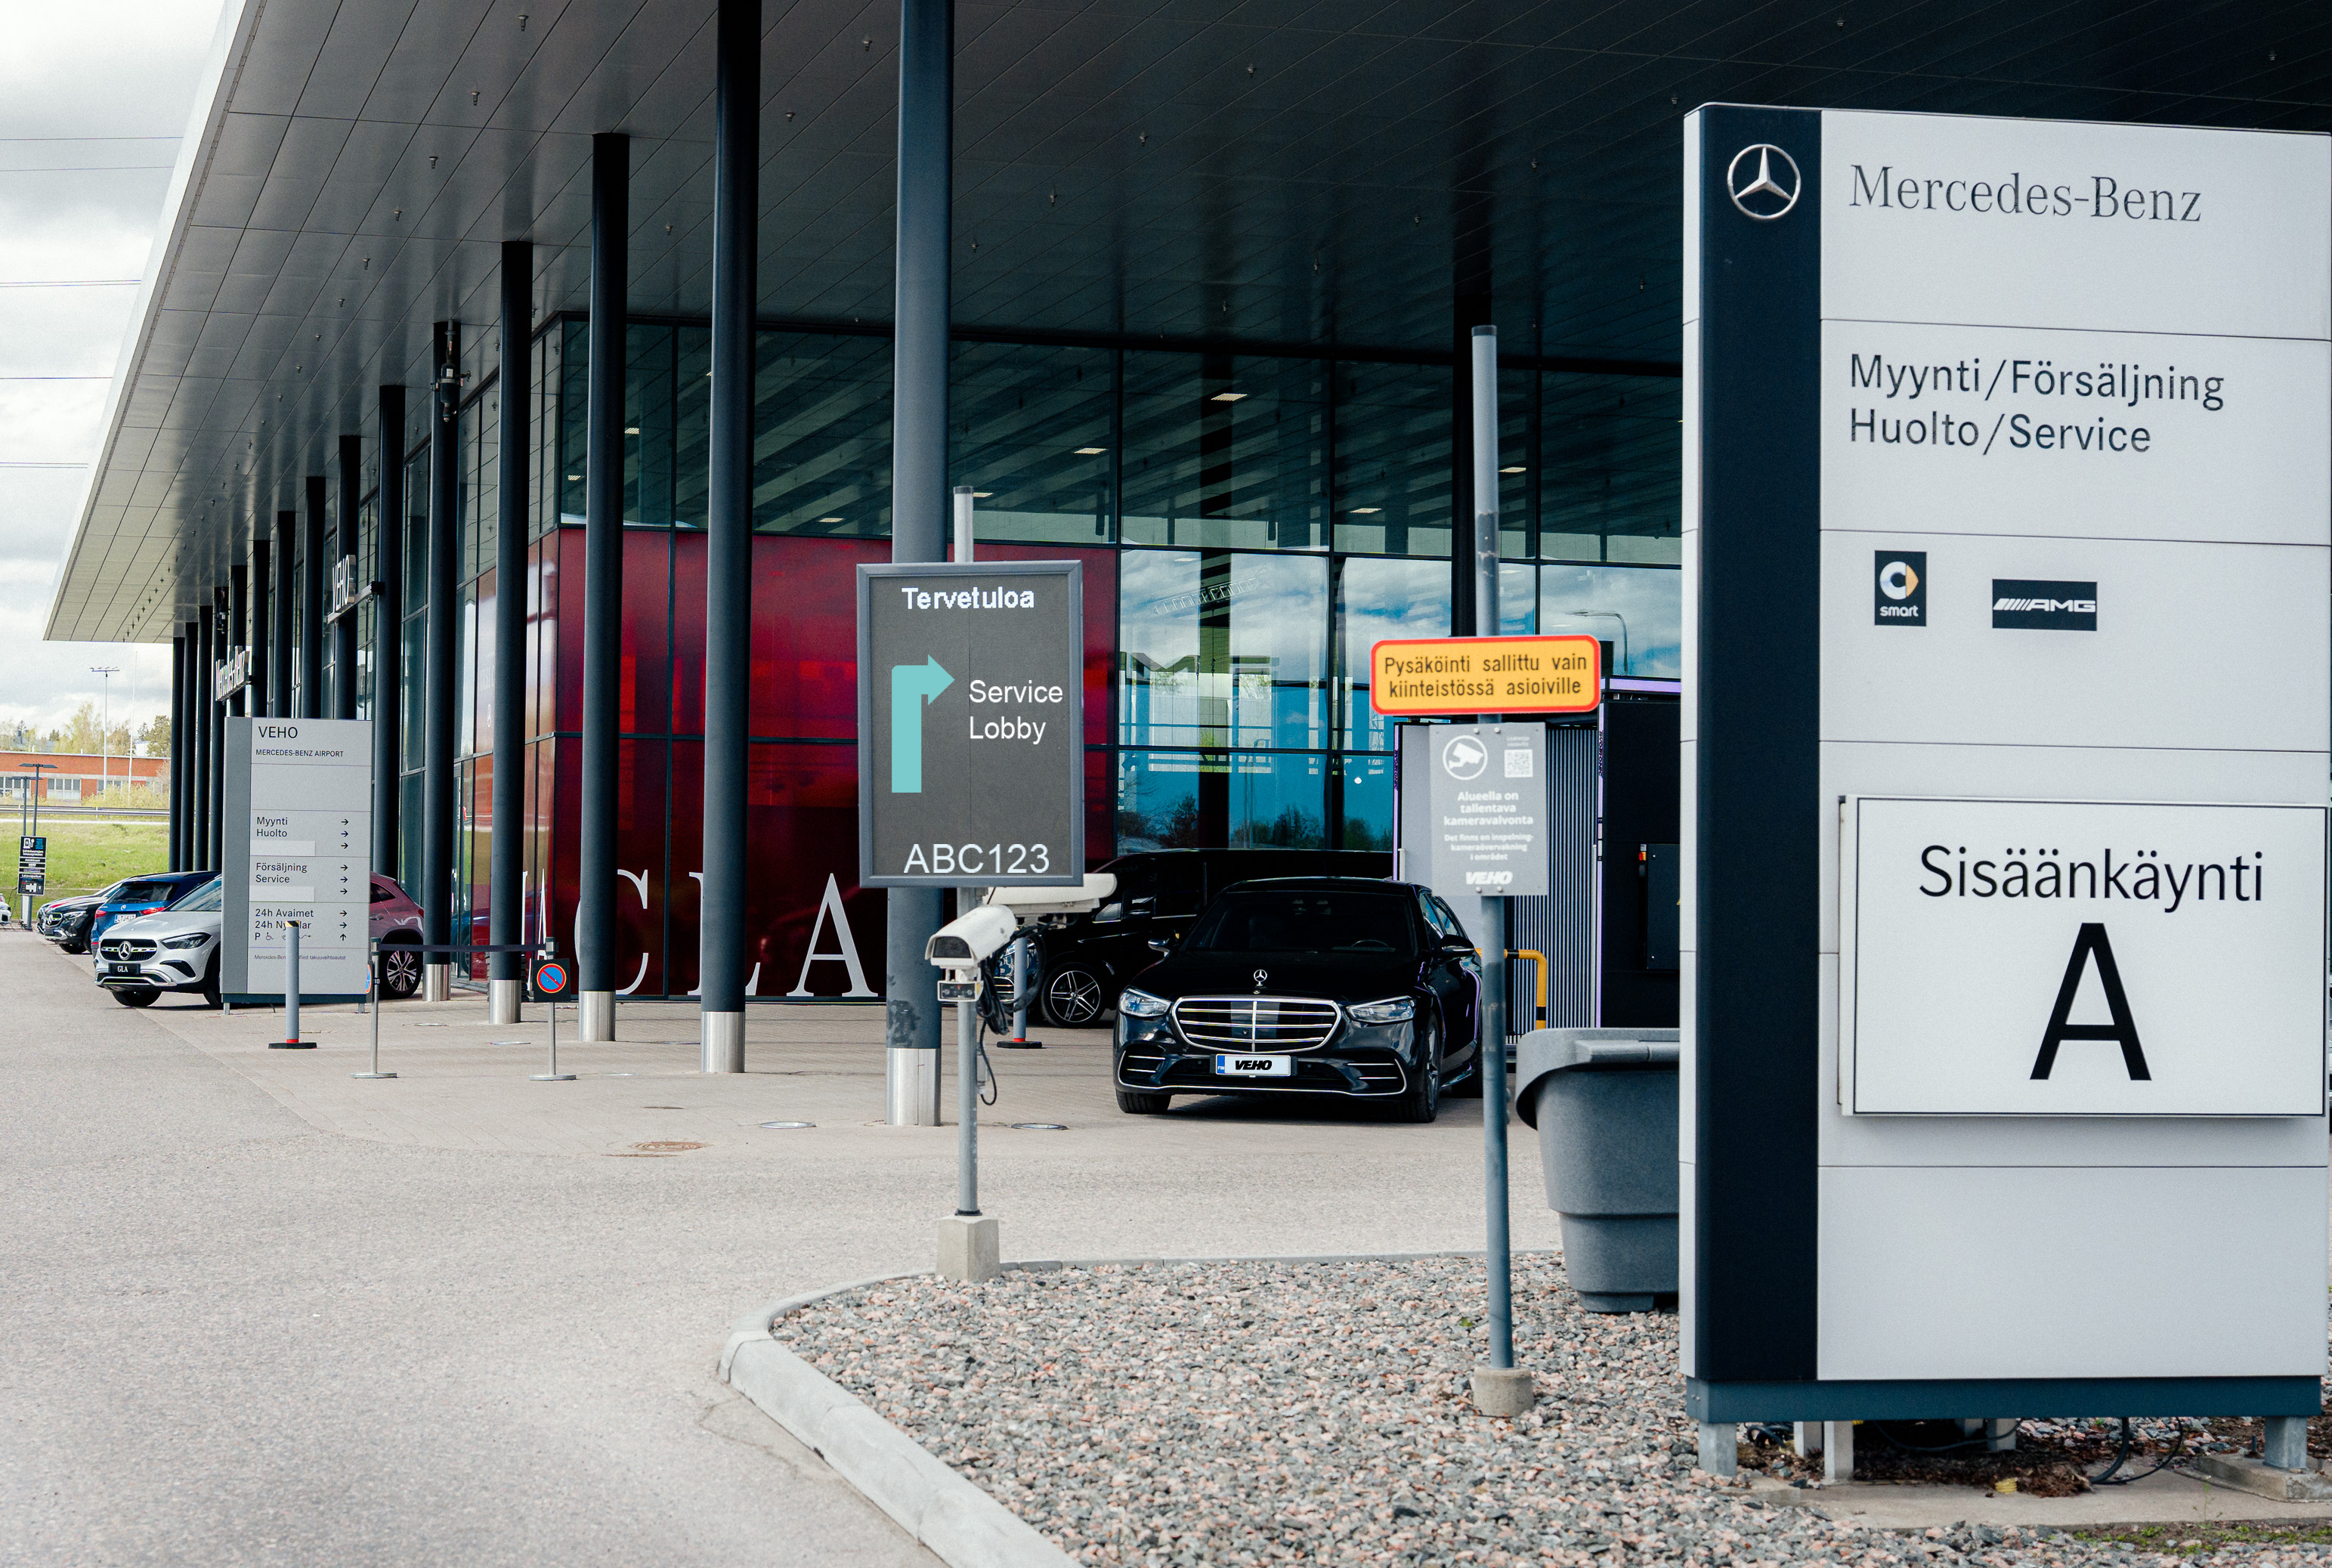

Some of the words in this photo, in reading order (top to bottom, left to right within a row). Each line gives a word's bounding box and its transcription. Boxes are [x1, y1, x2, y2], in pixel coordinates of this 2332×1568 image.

[1849, 164, 2203, 222] Mercedes-Benz
[1850, 353, 2225, 411] Myynti/Försäljning
[1850, 408, 2151, 456] Huolto/Service
[902, 586, 1035, 609] Tervetuloa
[1879, 605, 1919, 617] smart
[2026, 598, 2096, 613] AMG
[1384, 655, 1470, 676] Pysäköinti
[1483, 654, 1539, 672] sallittu
[1552, 653, 1587, 670] vain
[969, 679, 1063, 704] Service
[1389, 679, 1494, 697] kiinteistössä
[1506, 677, 1581, 695] asioiville
[258, 725, 298, 738] VEHO
[970, 716, 1047, 744] Lobby
[1457, 790, 1502, 801] Alueella
[1504, 792, 1519, 801] on
[1460, 803, 1517, 813] tallentava
[257, 816, 288, 827] Myynti
[1443, 815, 1534, 826] kameravalvonta
[256, 828, 288, 837] Huolto
[903, 843, 1050, 874] ABC123
[255, 862, 308, 874] Försäljning
[255, 874, 290, 883] Service
[1465, 871, 1514, 885] VEHO
[1919, 845, 2264, 913] Sisäänkäynti
[255, 908, 273, 917] 24h
[276, 908, 314, 917] Avaimet
[255, 920, 273, 929] 24h
[276, 920, 312, 930] Nylar
[255, 932, 261, 941] P
[2030, 922, 2152, 1081] A
[1235, 1059, 1273, 1071] VEHO
